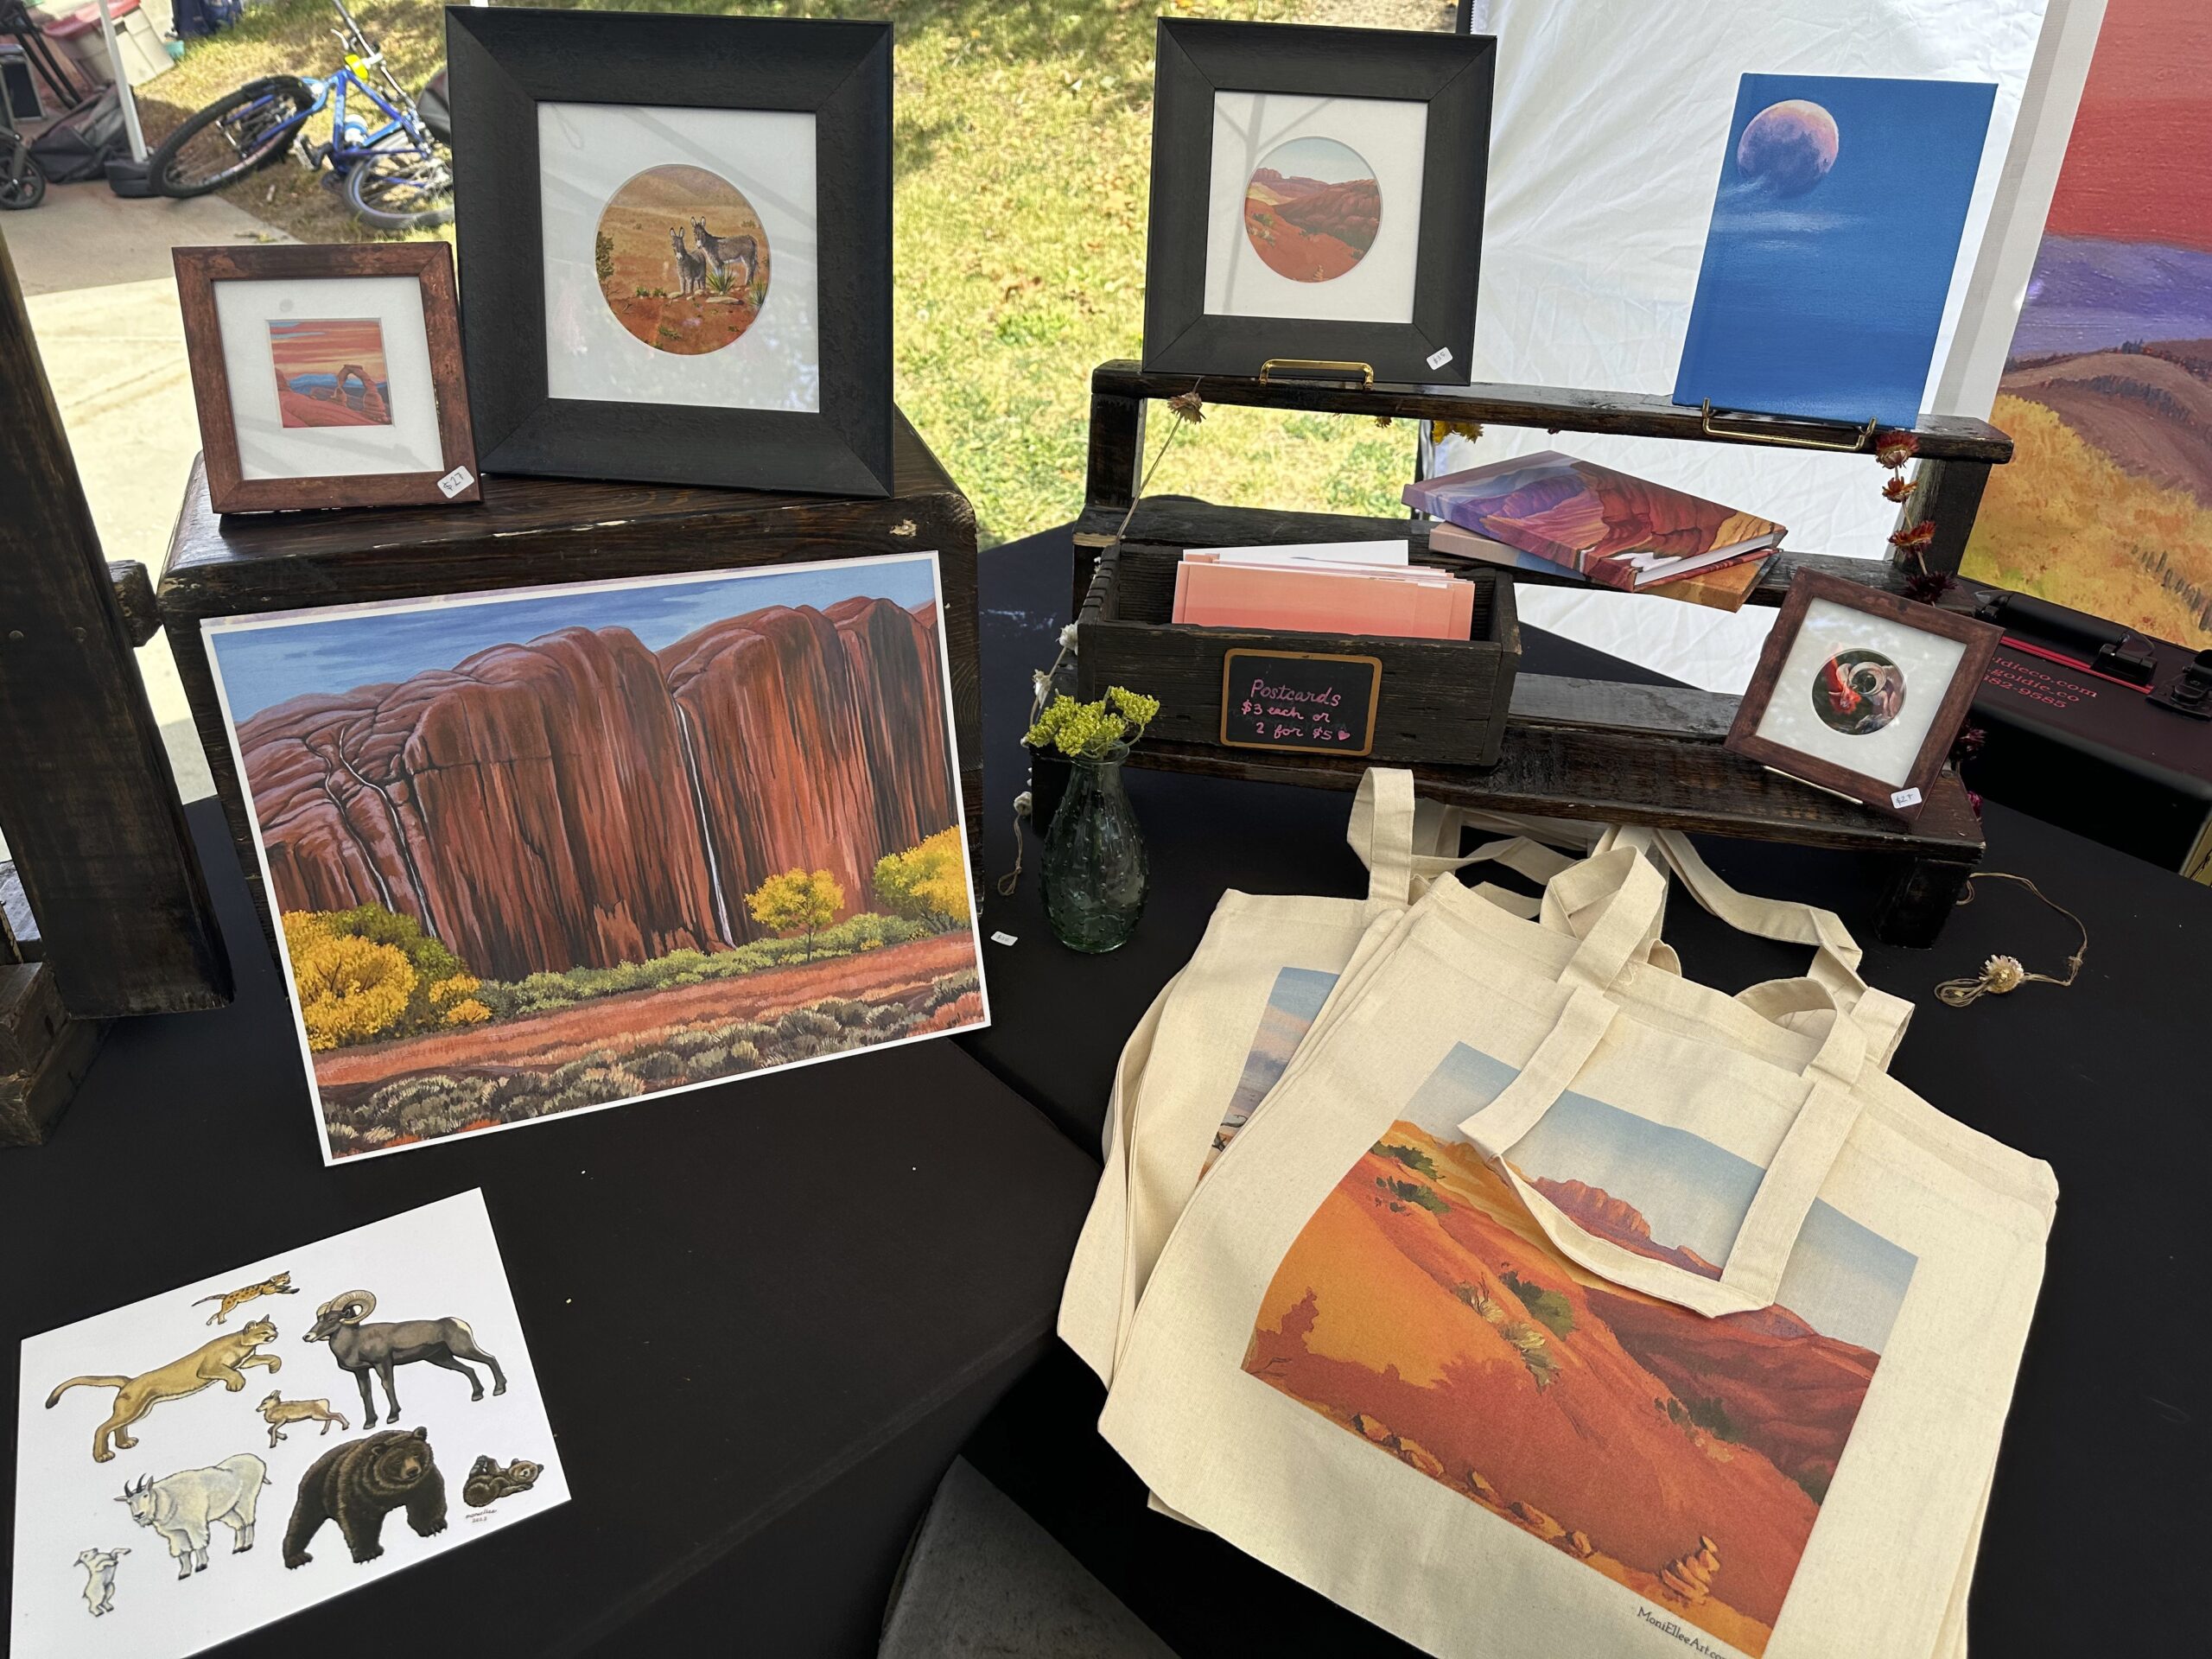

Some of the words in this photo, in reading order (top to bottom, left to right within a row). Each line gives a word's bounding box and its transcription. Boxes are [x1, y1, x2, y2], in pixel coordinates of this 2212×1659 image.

[442, 472, 464, 491] $27
[1992, 657, 2098, 698] ldieco.com
[1250, 678, 1342, 707] Postcards
[1241, 699, 1263, 715] $3
[1267, 706, 1305, 720] each
[1312, 711, 1331, 723] or
[1255, 721, 1265, 734] 2
[1274, 724, 1304, 739] for
[1313, 726, 1333, 741] $5
